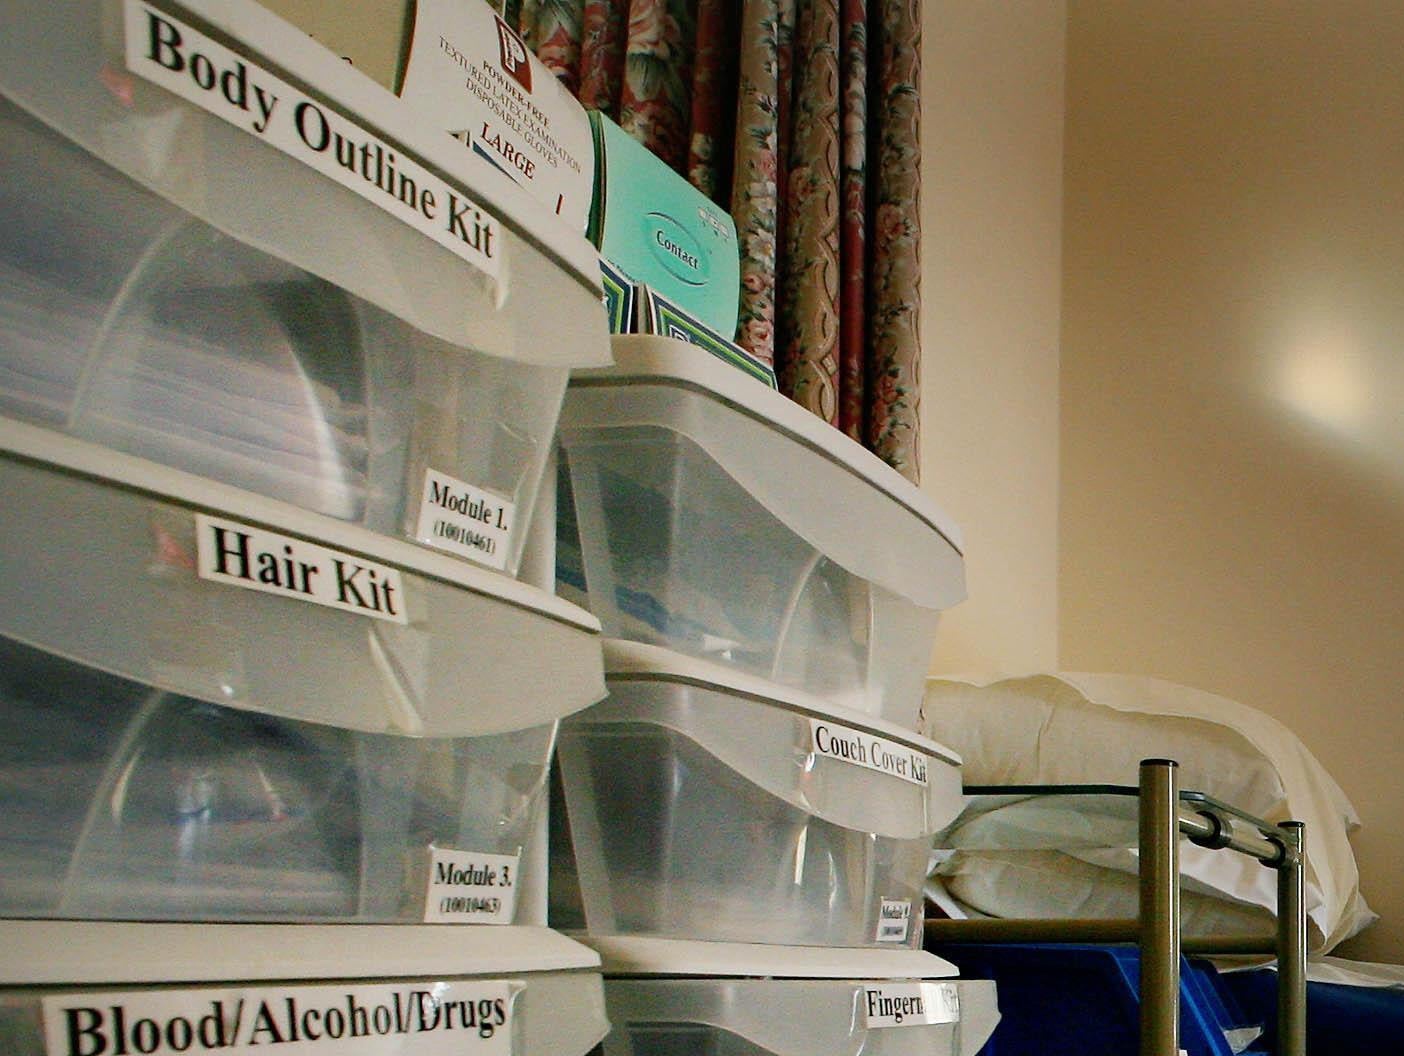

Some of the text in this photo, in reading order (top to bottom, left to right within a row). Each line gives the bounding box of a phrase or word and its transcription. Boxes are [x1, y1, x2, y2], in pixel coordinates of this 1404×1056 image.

[440, 36, 582, 175] TEXTURED LATEX EXAMINATION
[466, 78, 558, 169] DISPOSABLE GLOVES
[482, 60, 550, 128] POWDER-FREE
[144, 10, 494, 259] Body Outline Kit
[481, 122, 536, 180] LARGE
[656, 230, 699, 270] Contact
[429, 480, 508, 531] Module 1.
[208, 525, 397, 616] Hair Kit
[815, 726, 927, 784] Couch Cover Kit
[434, 862, 512, 888] Module 3.
